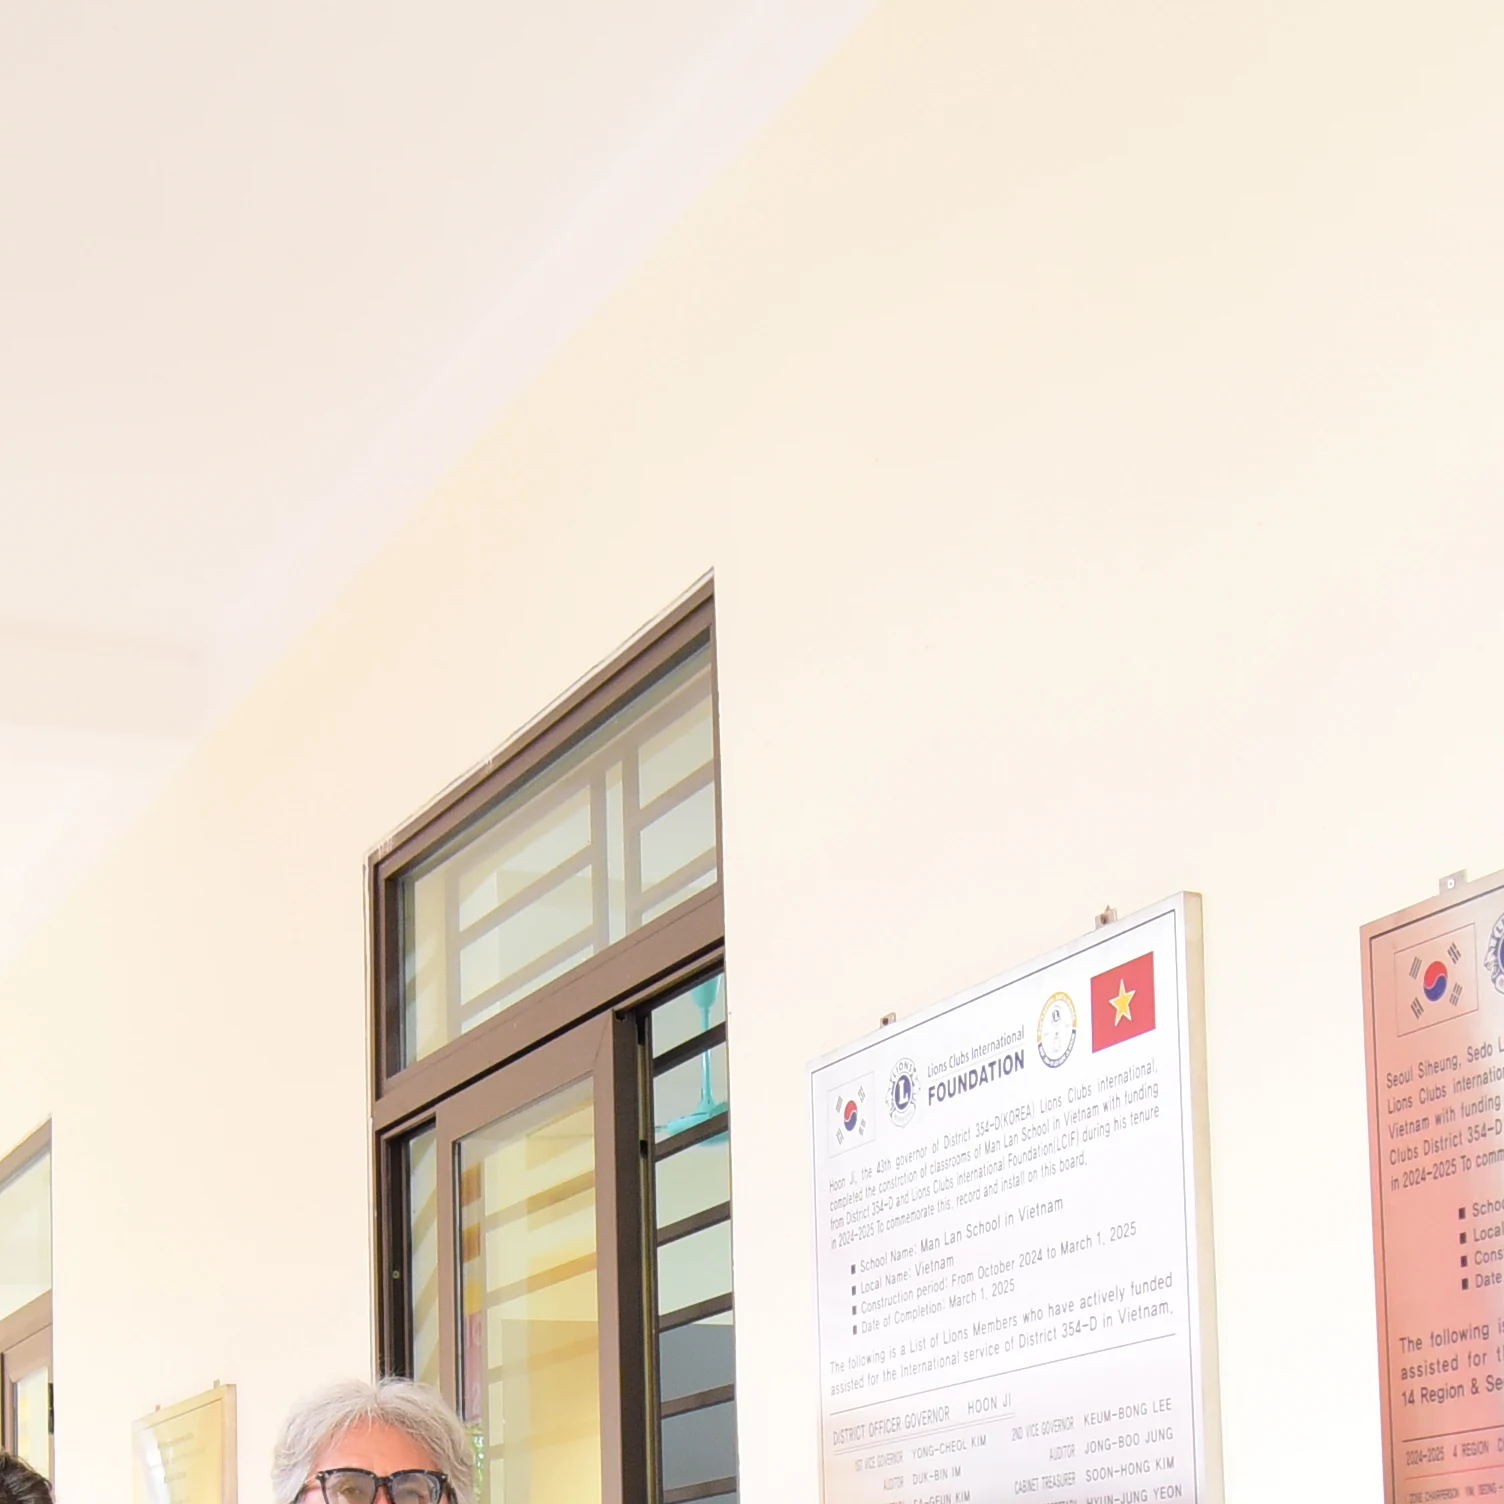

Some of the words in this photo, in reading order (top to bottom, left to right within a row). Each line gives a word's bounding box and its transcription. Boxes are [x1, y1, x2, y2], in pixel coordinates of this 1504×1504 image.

[927, 1061, 948, 1078] Lions
[949, 1051, 969, 1069] Clubs
[971, 1025, 1024, 1060] International
[1386, 1066, 1413, 1089] Seoul
[1418, 1055, 1462, 1079] Siheung,
[1467, 1041, 1493, 1063] Sedo
[898, 1077, 908, 1105] L
[928, 1049, 1024, 1106] FOUNDATION
[1387, 1096, 1413, 1115] Lions
[1419, 1084, 1447, 1105] Clubs
[1388, 1116, 1430, 1139] Vietnam
[1434, 1106, 1456, 1126] with
[1461, 1095, 1501, 1118] funding
[1390, 1176, 1400, 1191] in
[1403, 1158, 1457, 1188] 2024-2025
[1460, 1154, 1472, 1172] To
[860, 1252, 888, 1273] School
[890, 1244, 916, 1263] Name:
[920, 1238, 940, 1253] Man
[944, 1230, 962, 1246] Lan
[966, 1214, 1000, 1239] School
[1005, 1214, 1014, 1226] in
[1018, 1198, 1063, 1222] Vietnam
[1473, 1221, 1504, 1243] Local
[860, 1276, 882, 1294] Local
[885, 1268, 911, 1286] Name:
[914, 1256, 954, 1277] Vietnam
[830, 1361, 845, 1373] The
[848, 1350, 885, 1369] following
[889, 1347, 896, 1359] is
[900, 1345, 906, 1356] a
[910, 1337, 926, 1354] List
[930, 1333, 939, 1348] of
[943, 1328, 968, 1345] Lions
[973, 1315, 1018, 1336] Members
[1022, 1308, 1043, 1324] who
[1048, 1300, 1074, 1318] have
[1080, 1285, 1125, 1310] actively
[1131, 1272, 1173, 1296] funded
[1401, 1353, 1459, 1381] assisted
[1467, 1351, 1488, 1368] for
[1401, 1389, 1415, 1406] 14
[1420, 1383, 1465, 1404] Region
[1470, 1377, 1480, 1395] &
[833, 1424, 866, 1446] DISTRICT
[868, 1416, 902, 1438] OFFICER
[904, 1405, 950, 1430] GOVERNOR
[968, 1396, 997, 1415] HOON
[1002, 1393, 1011, 1408] JI
